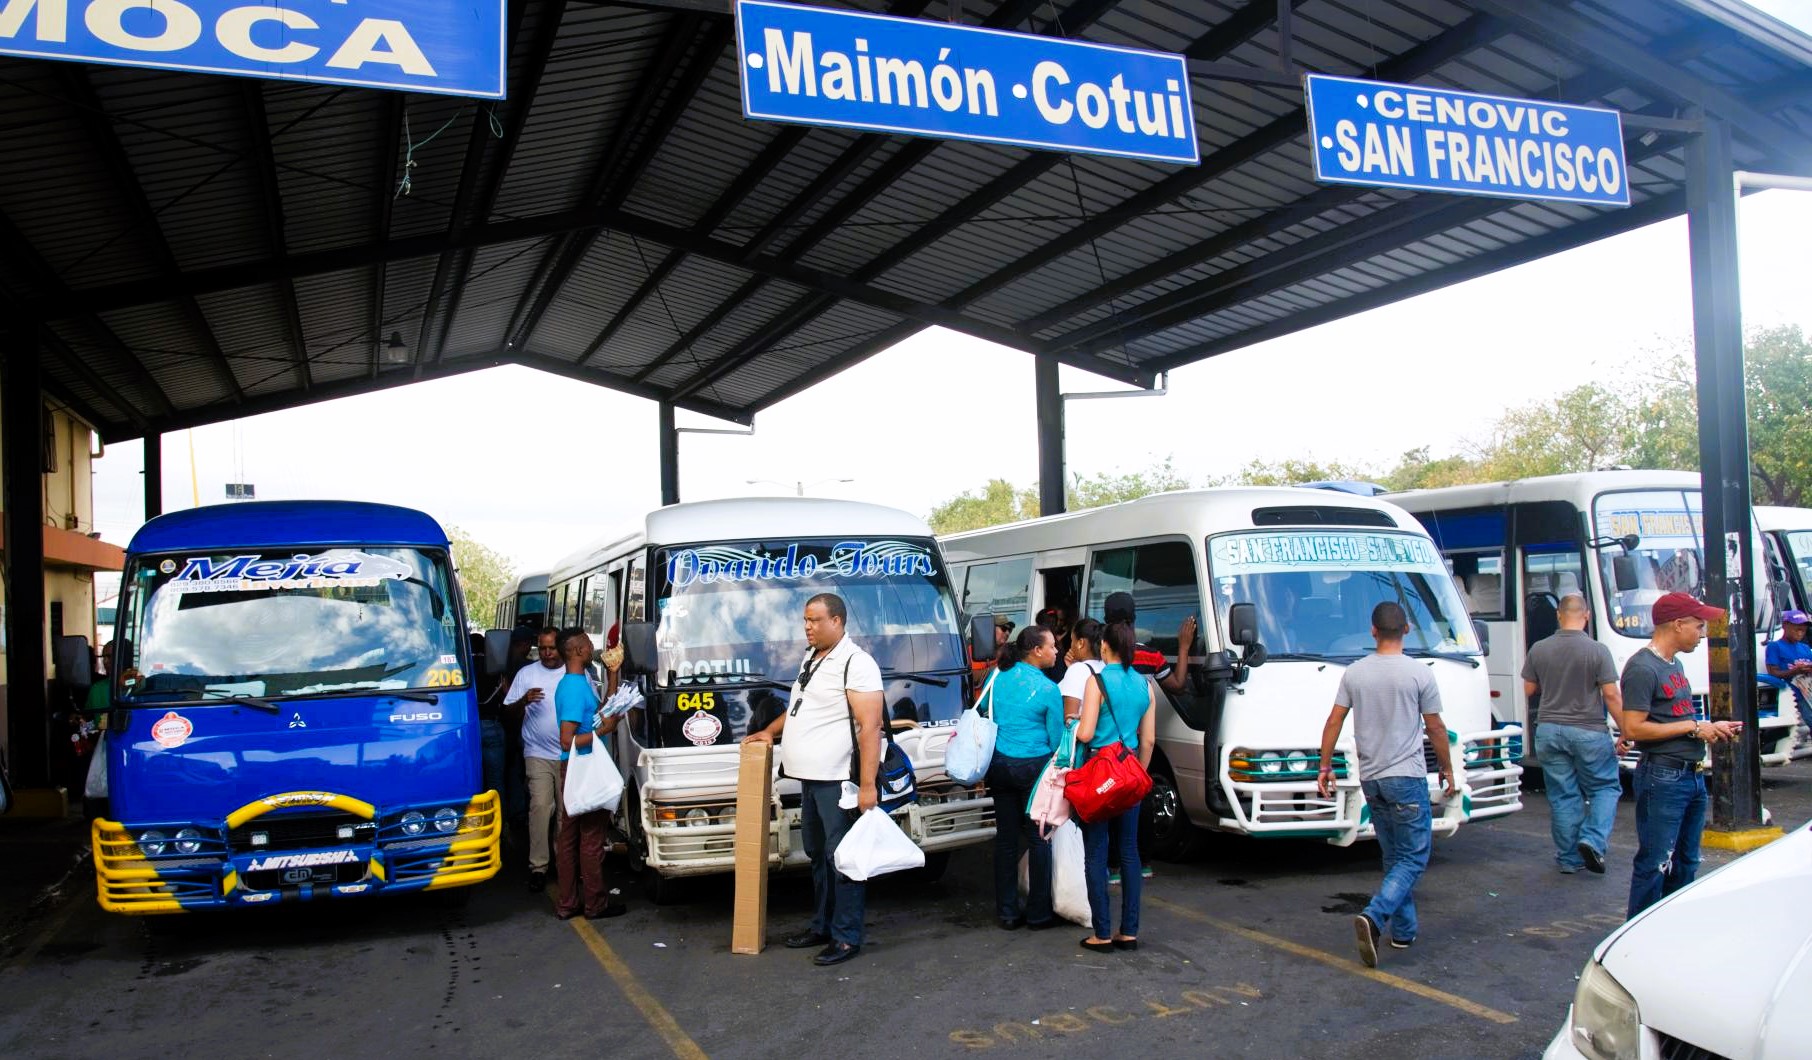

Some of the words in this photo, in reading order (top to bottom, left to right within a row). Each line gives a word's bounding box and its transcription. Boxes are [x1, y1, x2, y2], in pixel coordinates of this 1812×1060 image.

[763, 28, 999, 117] Maimón
[1032, 60, 1186, 139] Cotui
[1373, 90, 1569, 137] CENOVIC
[1335, 119, 1415, 176] SAN
[1425, 129, 1620, 195] FRANCISCO
[1643, 514, 1703, 536] FRANCISC
[1226, 537, 1266, 564] SAN
[1269, 536, 1361, 562] FRANCISCO
[666, 543, 817, 587] Ovando
[832, 541, 938, 577] Tours
[1615, 616, 1639, 628] 418
[427, 669, 463, 688] 206
[678, 659, 750, 684] COTUI
[677, 692, 715, 711] 645
[389, 712, 443, 722] FUSO
[261, 851, 348, 871] MITSUBISHI
